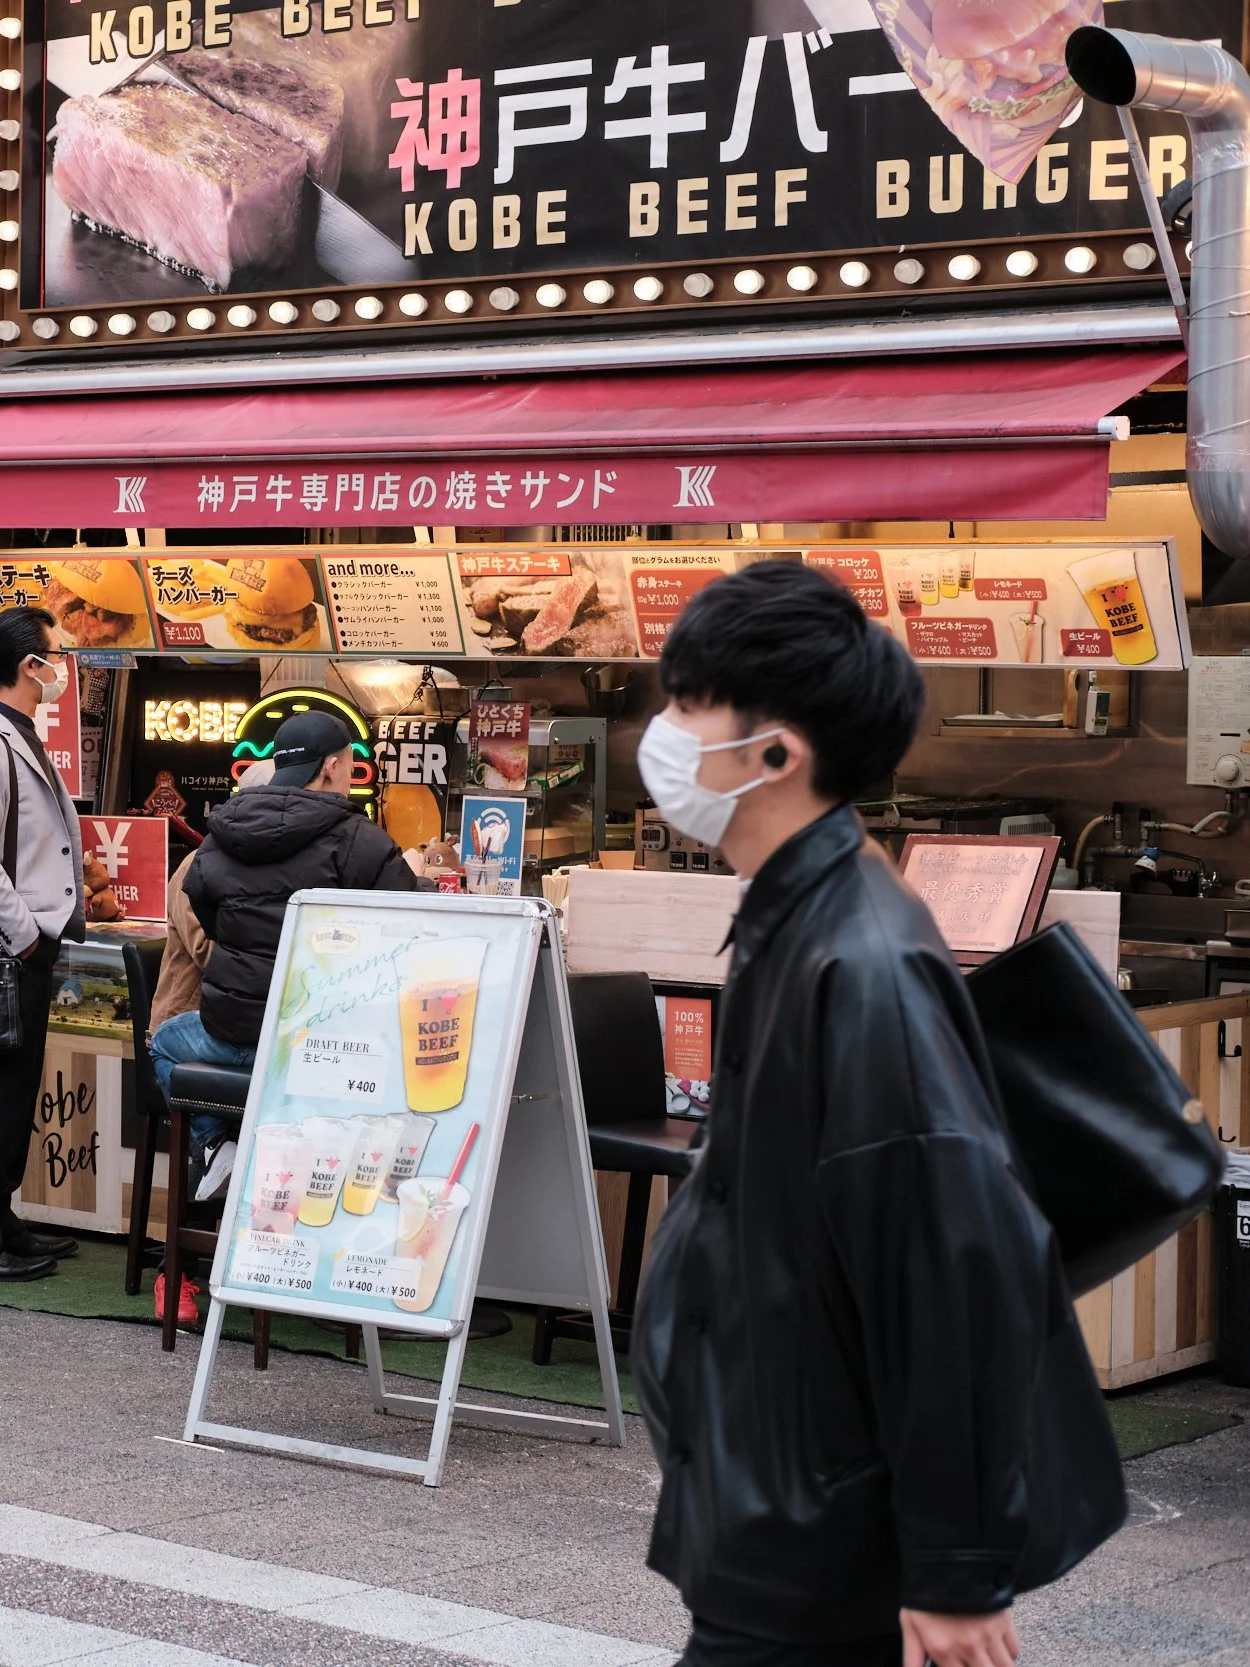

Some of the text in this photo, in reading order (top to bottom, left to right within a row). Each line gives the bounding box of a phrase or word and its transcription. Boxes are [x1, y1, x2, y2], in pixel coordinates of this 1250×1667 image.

[89, 0, 232, 63] KOBE
[388, 28, 1084, 192] 神戸牛バー
[403, 189, 567, 256] KOBE
[629, 168, 808, 238] BEEF
[196, 469, 618, 514] 神戸牛専門店の焼きサンド
[327, 560, 415, 576] and more...
[461, 556, 561, 574] 神戸牛ステーキ
[837, 557, 870, 567] コロッケ
[152, 565, 194, 583] チーズ
[853, 568, 878, 580] ¥200
[637, 576, 683, 589] 赤身ステーキ
[993, 580, 1023, 588] レモネード
[158, 586, 238, 604] ハンバーガー
[845, 588, 884, 598] ンチカツ
[1104, 602, 1137, 618] KOBE
[343, 616, 406, 624] サムライハンバーガー
[1109, 613, 1139, 628] BEEF
[165, 625, 201, 641] ¥1,100
[346, 630, 447, 638] コロッケバーガー ¥500
[1069, 632, 1101, 641] 生ビール
[1076, 644, 1100, 654] ¥400
[477, 704, 525, 719] ひとくち
[145, 700, 247, 742] KOBE
[378, 720, 437, 741] BEEF
[476, 719, 522, 738] 神戸牛
[92, 820, 132, 879] ¥
[674, 1011, 704, 1024] 100%
[417, 1017, 460, 1035] KOBE
[674, 1024, 704, 1037] 神戸牛
[305, 1037, 370, 1053] DRAFT BEER
[418, 1035, 459, 1051] BEEF
[302, 1052, 341, 1064] 生ビール
[347, 1079, 376, 1093] ¥400
[33, 1070, 95, 1132] obe
[42, 1131, 101, 1188] Beef
[356, 1164, 381, 1174] KOBE
[311, 1171, 338, 1182] KOBE
[355, 1172, 378, 1183] BEEF
[309, 1181, 335, 1192] BEEF
[261, 1188, 291, 1200] KOBE
[260, 1200, 289, 1211] BEEF
[282, 1258, 312, 1269] ドリンク
[347, 1253, 388, 1265] LEMONADE
[345, 1265, 383, 1276] レモネード
